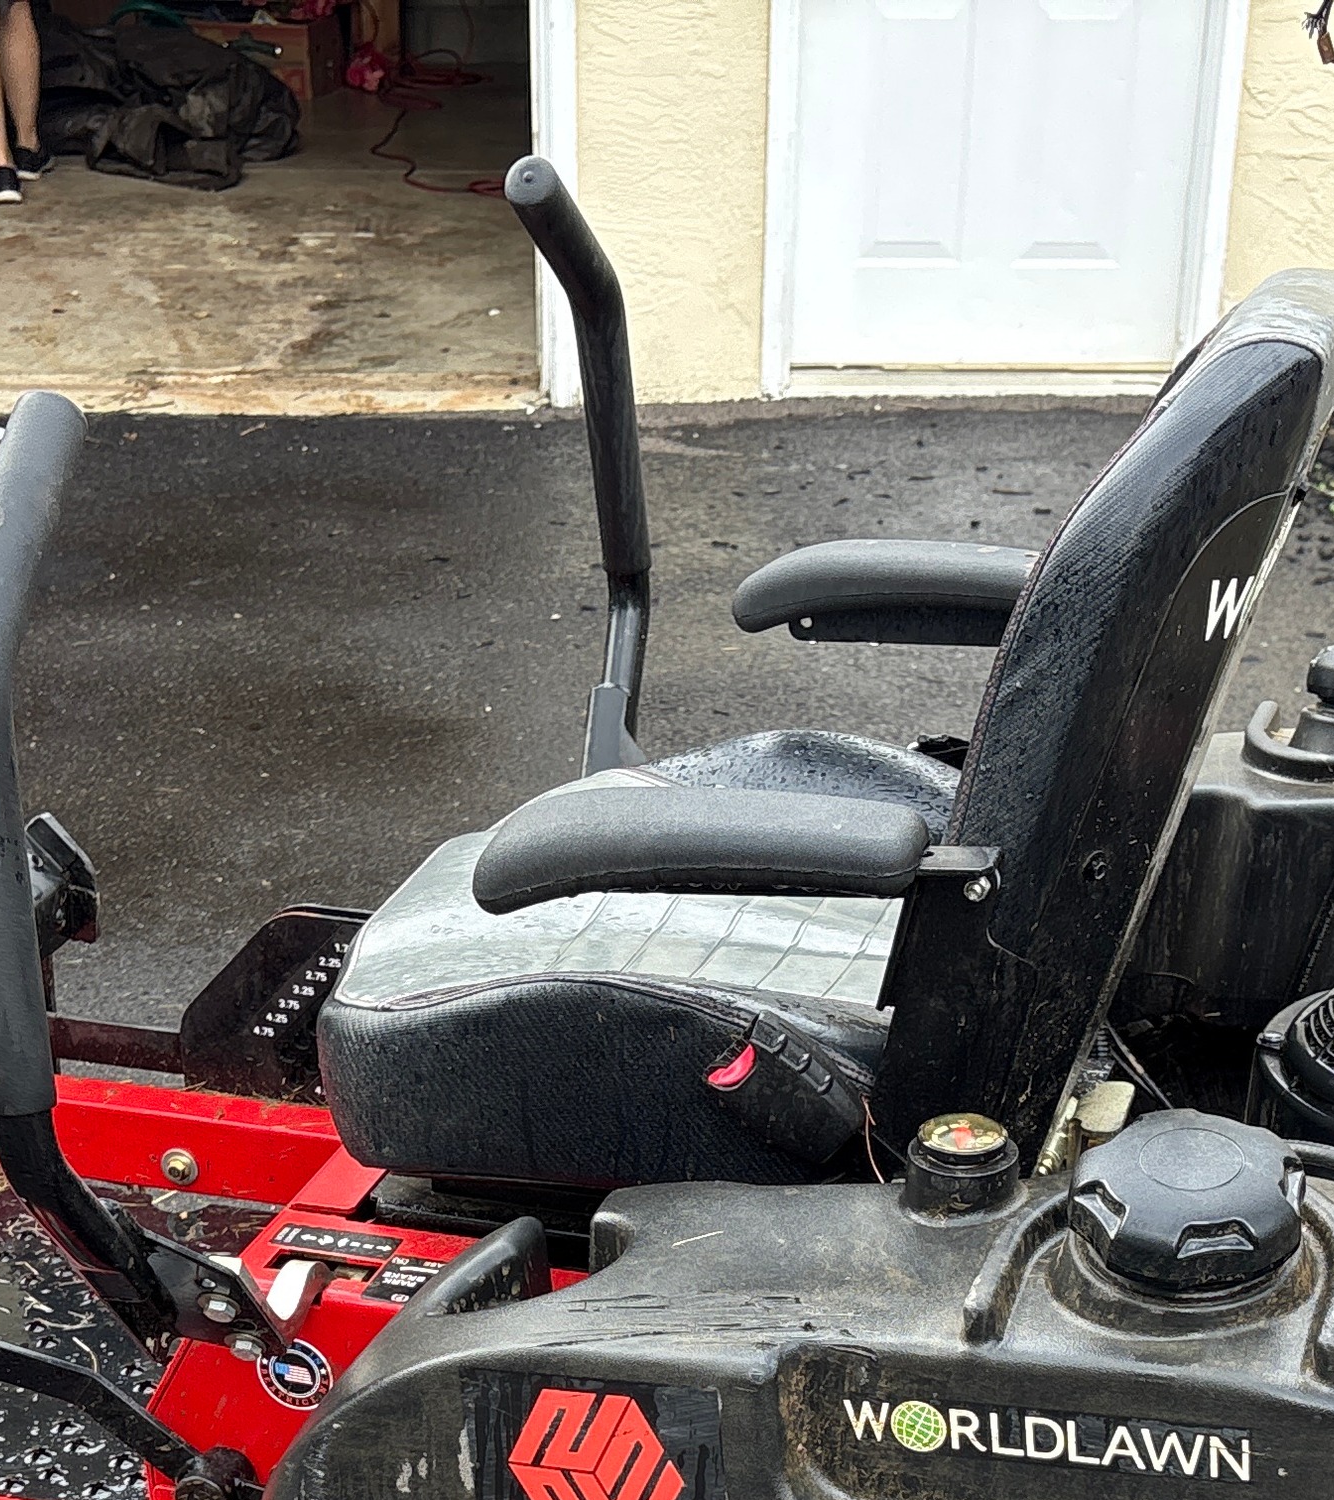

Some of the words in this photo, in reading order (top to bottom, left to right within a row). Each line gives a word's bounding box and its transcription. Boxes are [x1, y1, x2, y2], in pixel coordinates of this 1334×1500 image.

[334, 942, 349, 953] 1.7
[319, 956, 342, 968] 2.25
[305, 970, 328, 982] 2.75
[292, 984, 315, 996] 3.25
[278, 998, 300, 1010] 3.75
[266, 1012, 288, 1024] 4.25
[253, 1025, 275, 1038] 4.75
[843, 1399, 1250, 1482] WORLDLAWN
